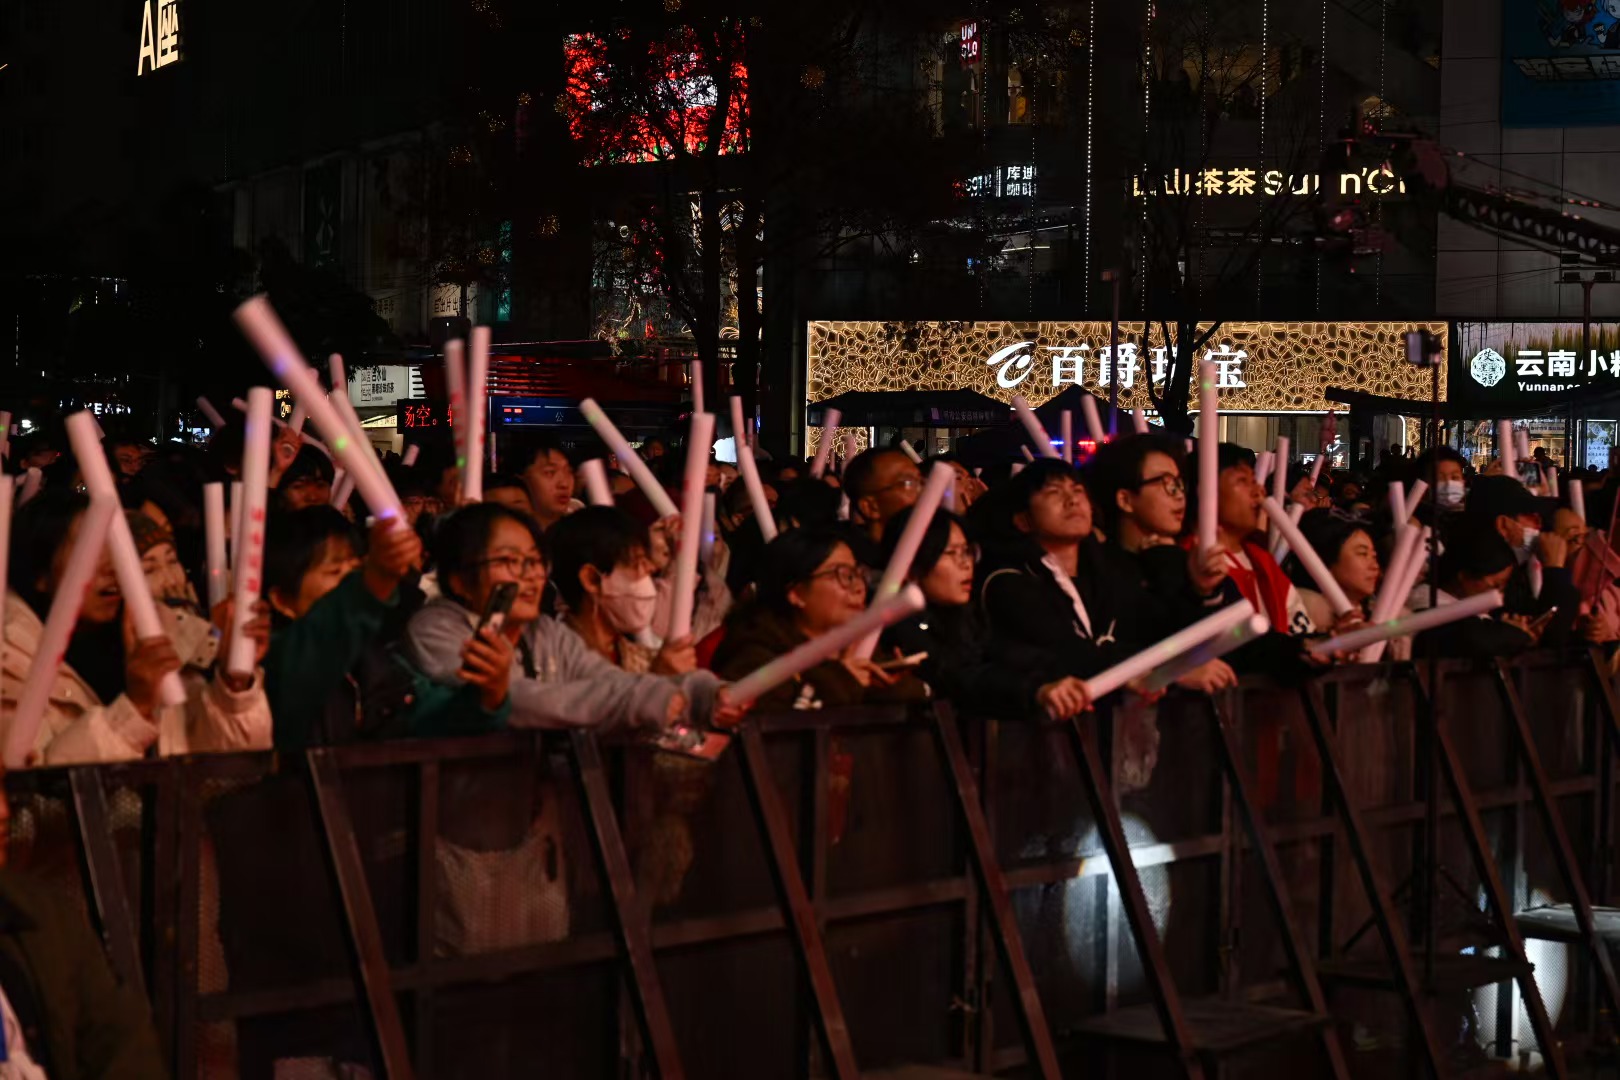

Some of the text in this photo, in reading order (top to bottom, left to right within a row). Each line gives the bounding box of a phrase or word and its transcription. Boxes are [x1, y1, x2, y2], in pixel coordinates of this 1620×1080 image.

[137, 0, 179, 76] A座
[1006, 165, 1037, 181] 库迪
[1517, 381, 1565, 392] Yunnan
